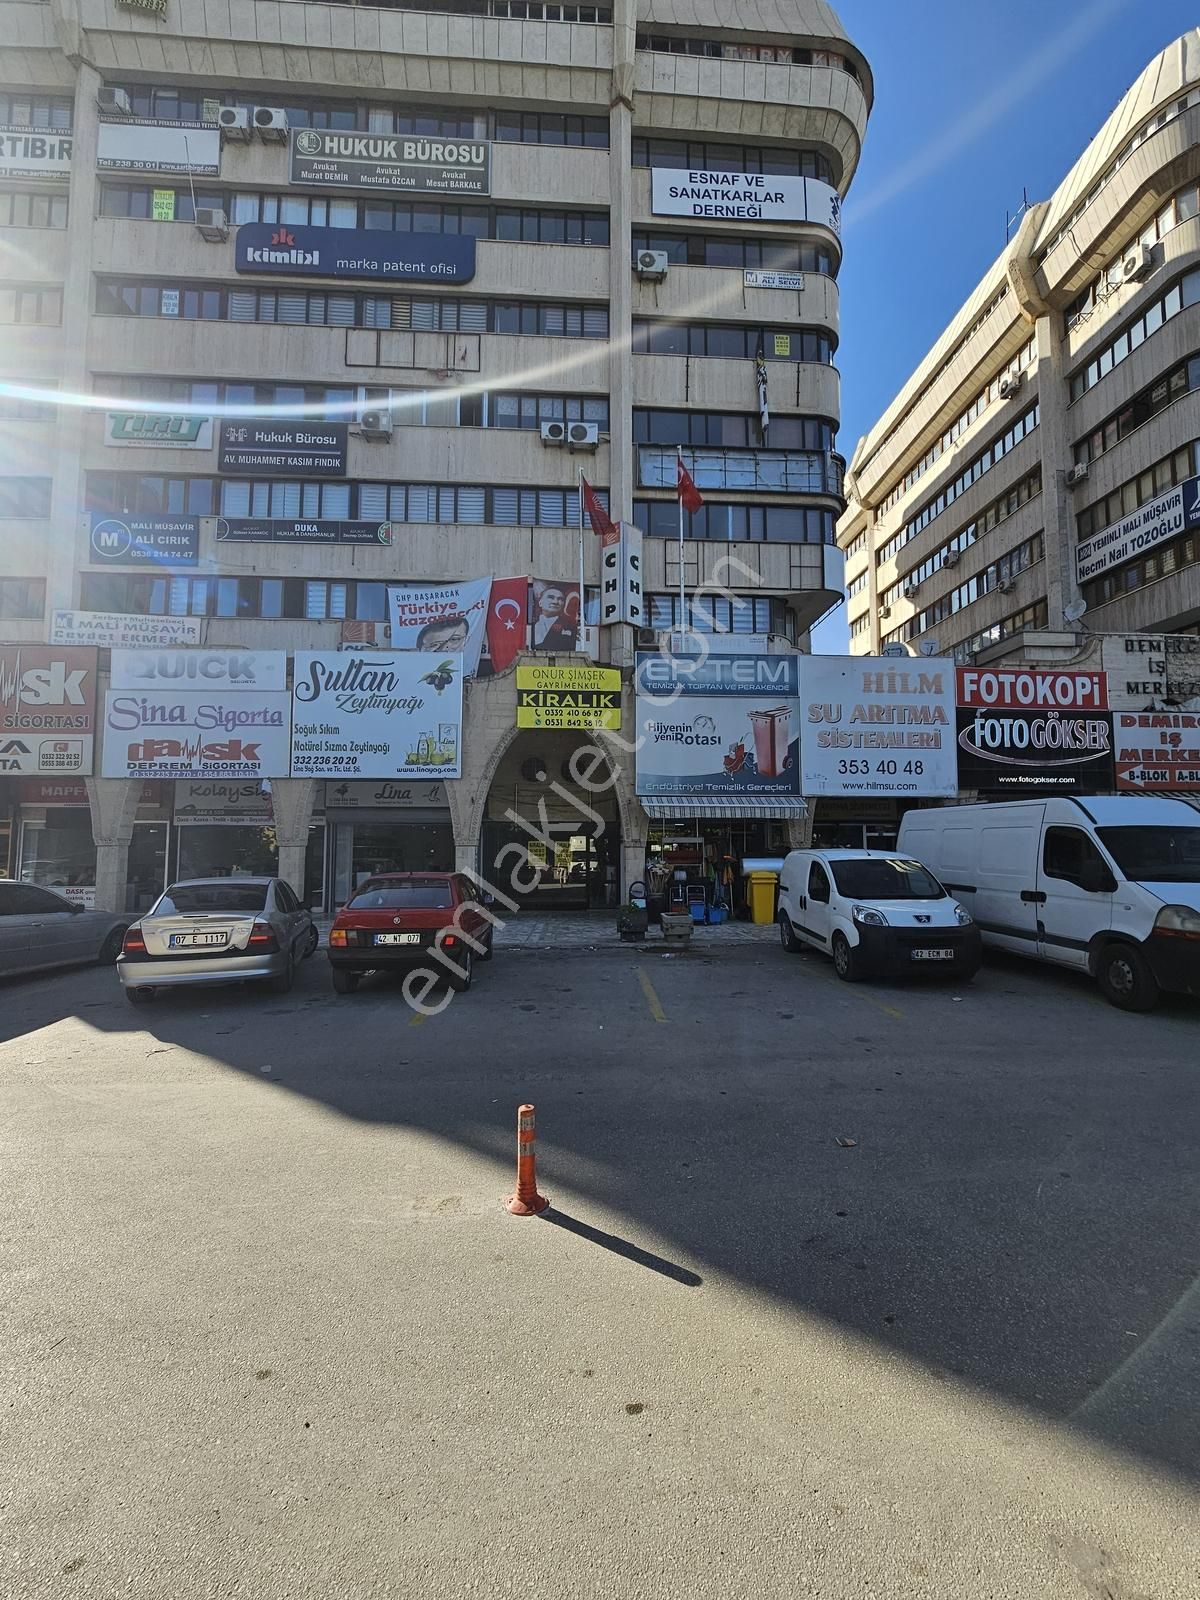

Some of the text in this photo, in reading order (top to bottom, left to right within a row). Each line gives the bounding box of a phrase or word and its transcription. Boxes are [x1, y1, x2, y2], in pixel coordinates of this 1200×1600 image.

[325, 136, 485, 163] HUKUK BÜROSU
[98, 158, 113, 166] Tel:
[313, 162, 338, 171] Avukat
[301, 170, 349, 182] Murat DEMİR
[376, 167, 401, 176] Avukat
[442, 171, 467, 180] Avukat
[360, 175, 416, 186] Mustafa ÖZCAN
[426, 179, 482, 190] Mesut BARKALE
[689, 172, 765, 187] ESNAF VE
[669, 186, 785, 203] SANATKARLAR
[693, 203, 763, 218] DERNEĞİ
[336, 258, 457, 275] marka patent ofisi
[255, 432, 337, 445] Hukuk Bürosu
[224, 454, 341, 467] AV. MUHAMMET KASIM FINDIK
[154, 522, 194, 532] MÜŞAVİR
[294, 524, 318, 532] DUKA
[1092, 494, 1181, 552] YEMİNLİ MALİ MÜŞAVİR
[135, 534, 190, 545] ALİ CIRIK
[1078, 513, 1182, 579] Necmi Nail TOZOĞLU
[605, 552, 617, 618] CHP
[629, 555, 640, 618] CHP
[395, 590, 460, 602] CHP BAŞARACAK
[397, 602, 457, 616] Türkiye
[54, 630, 114, 640] Cevdet
[123, 622, 196, 635] MÜŞAVİR
[130, 655, 256, 679] QUICK
[646, 658, 790, 685] ER-TEM
[295, 658, 400, 702] Sultan
[532, 669, 606, 682] ONUR ŞİMŞEK
[862, 666, 945, 695] HİLM
[537, 681, 601, 690] GAYRİMENKUL
[688, 683, 723, 691] TOPTAN
[738, 684, 790, 692] PERAKENDE
[335, 693, 425, 715] Zeytinyağı
[522, 691, 615, 708] KİRALIK
[108, 697, 284, 733] Sina Sigorta
[567, 709, 580, 717] 410
[807, 703, 950, 725] SU ARITMA
[4, 713, 90, 729] SİGORTASI
[567, 719, 581, 727] 842
[1120, 714, 1200, 728] DEMİR
[294, 723, 340, 737] Soğuk Sıkım
[648, 722, 692, 735] Hijyenin
[975, 711, 1110, 750] FOTO GÖKSER
[817, 728, 942, 750] SİSTEMLERİ
[294, 740, 390, 755] Natürel Sızma Zeytinyağı
[294, 756, 358, 765] 332 236 20 20
[1119, 748, 1200, 762] MERKE
[127, 762, 193, 770] DEPREM
[838, 759, 924, 775] 353 40 48
[999, 776, 1076, 785] www.fotogokser.com
[1128, 770, 1168, 781] B-BLOK
[374, 783, 413, 800] Lina
[645, 783, 792, 793] Endüstriyel Temizlik Gereçleri
[842, 781, 918, 791] www.hilmsu.com
[175, 934, 225, 945] 07 E 1117
[378, 934, 420, 943] 42 NT 077
